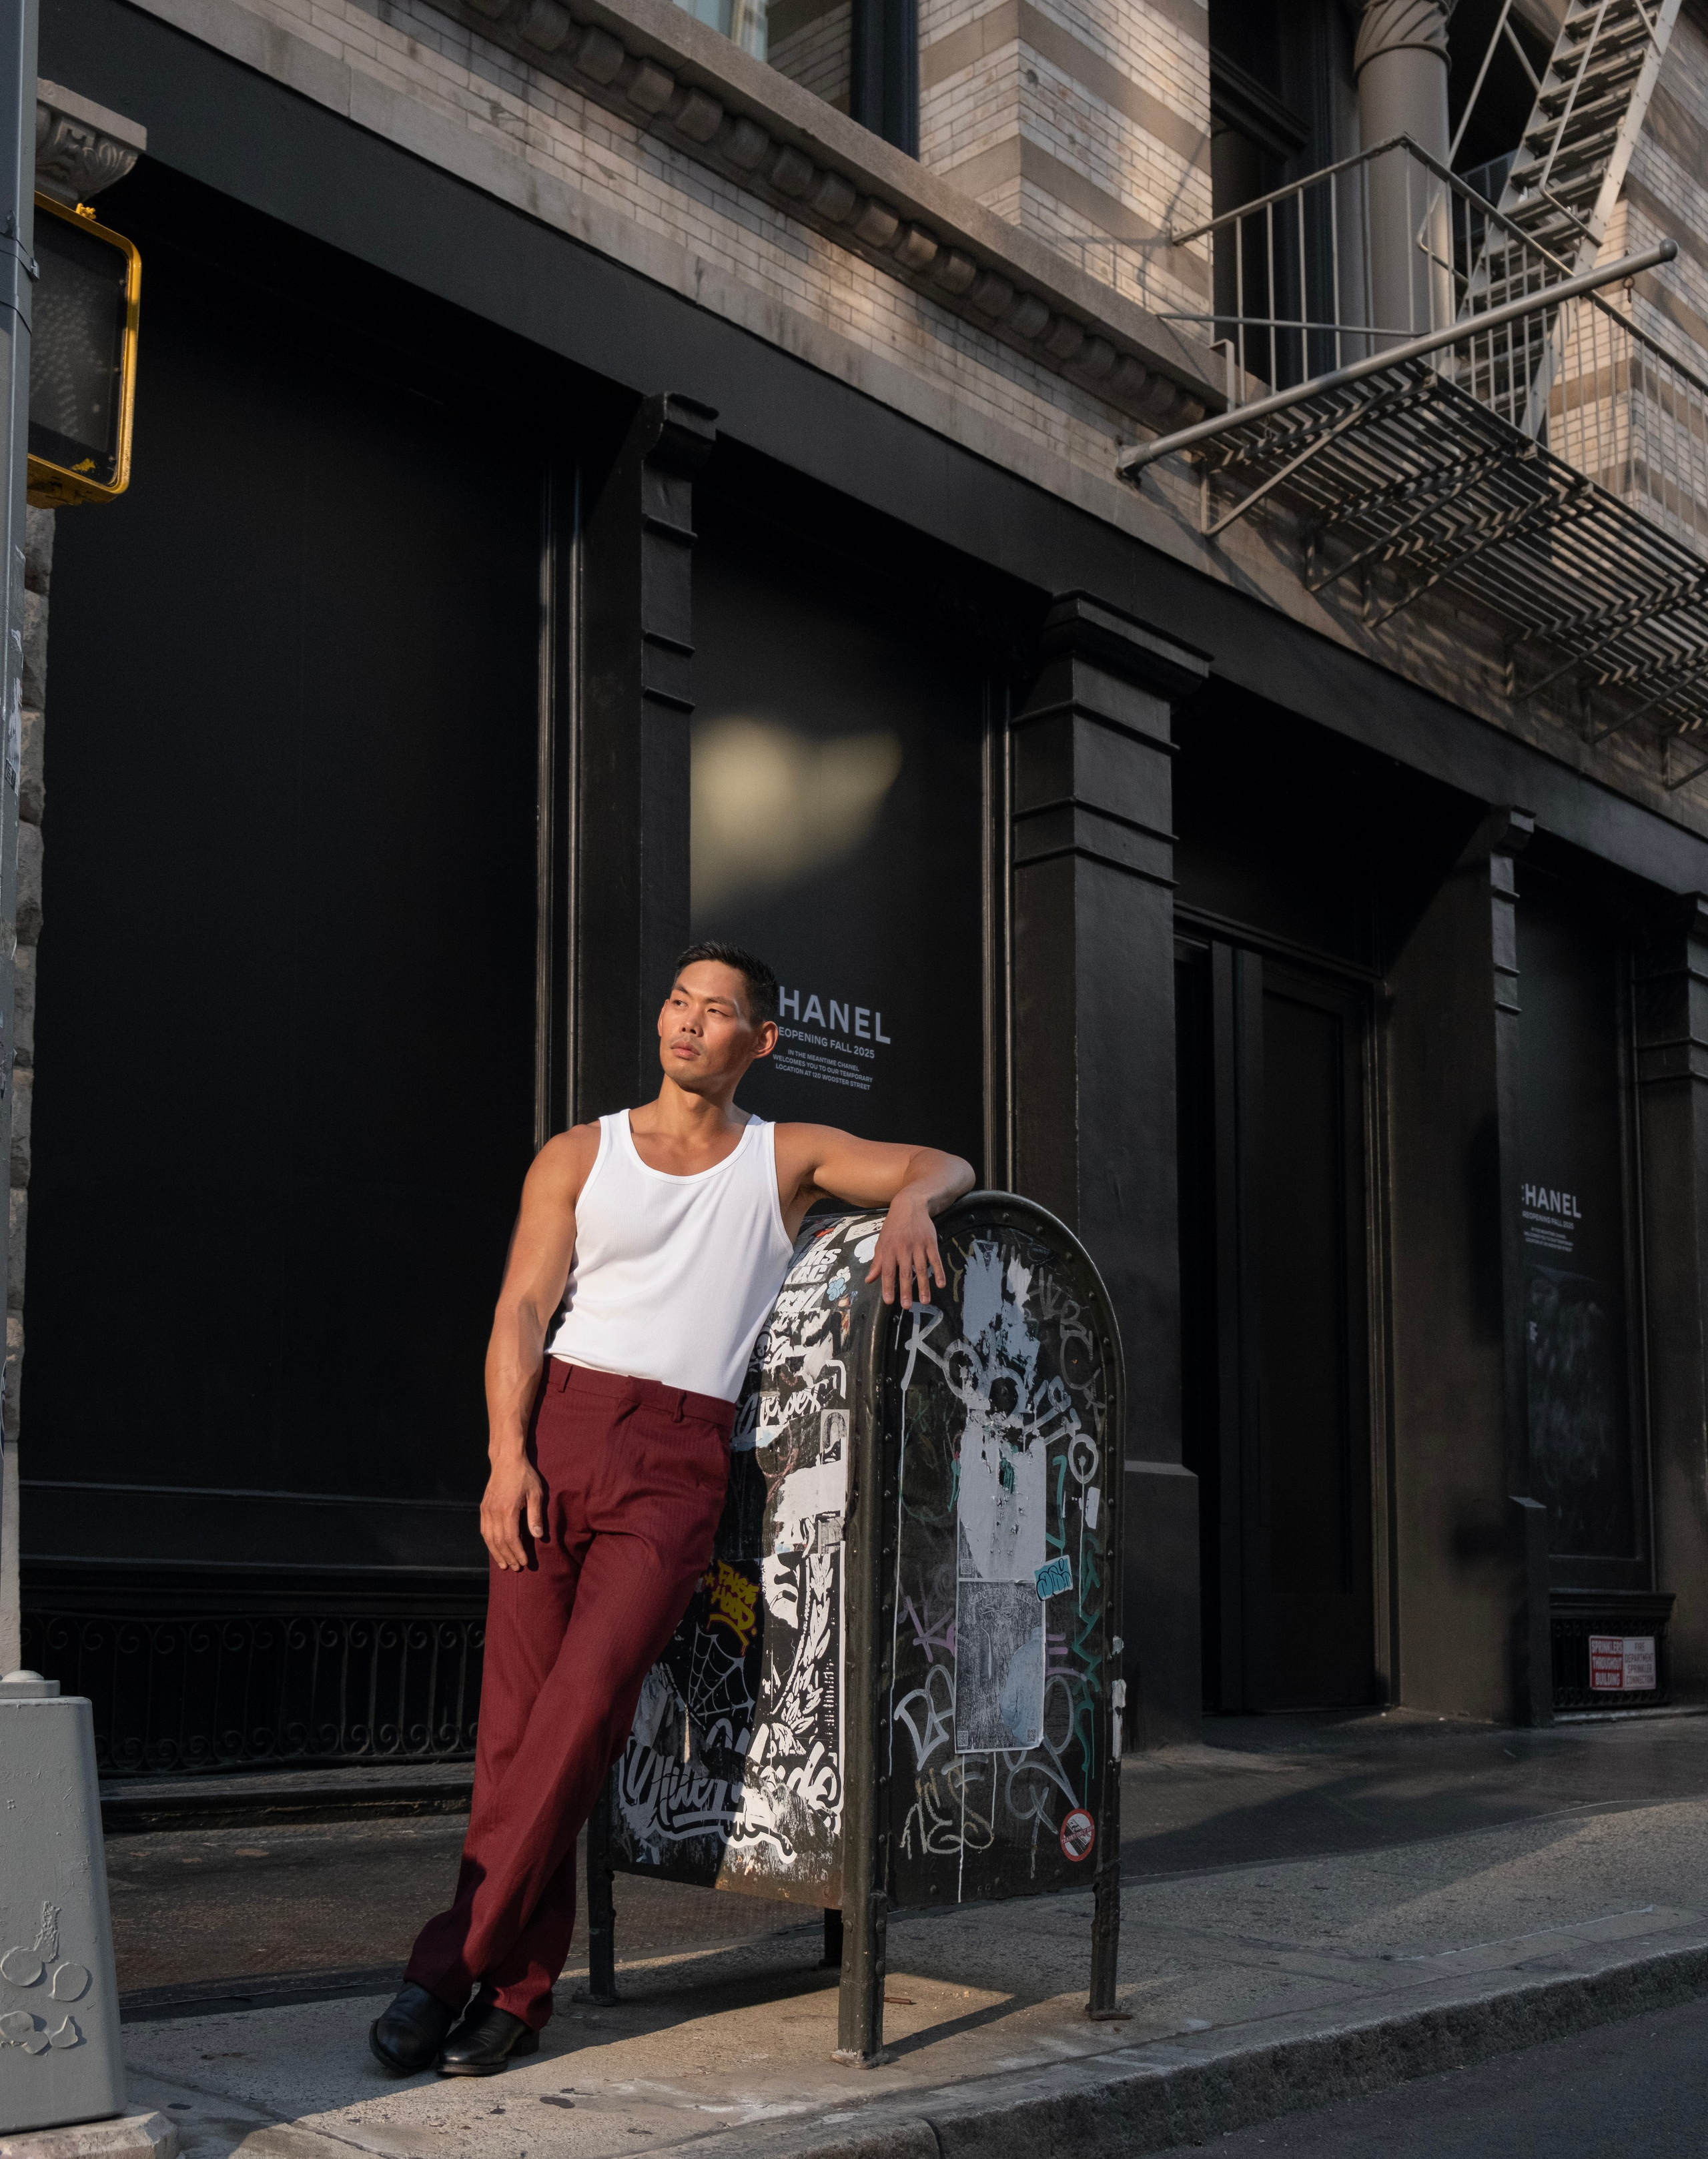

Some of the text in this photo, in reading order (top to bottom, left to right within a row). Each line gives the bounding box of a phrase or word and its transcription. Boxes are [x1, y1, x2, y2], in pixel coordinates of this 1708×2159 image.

[779, 985, 891, 1044] HANEL
[778, 1026, 875, 1059] EOPENING FALL 2025
[773, 1053, 806, 1067] WELCOMES
[807, 1062, 818, 1070] YOU
[827, 1067, 839, 1075] OUR
[840, 1069, 873, 1083] TEMPORARY
[795, 1050, 806, 1059] THE
[807, 1053, 837, 1066] MEANTIME
[837, 1061, 859, 1071] CHANEL
[775, 1063, 804, 1075] LOCATION
[822, 1074, 849, 1086] WOOSTER
[850, 1080, 871, 1091] STREET
[1521, 1183, 1582, 1219] HANEL
[1061, 1833, 1076, 1844] TRADES
